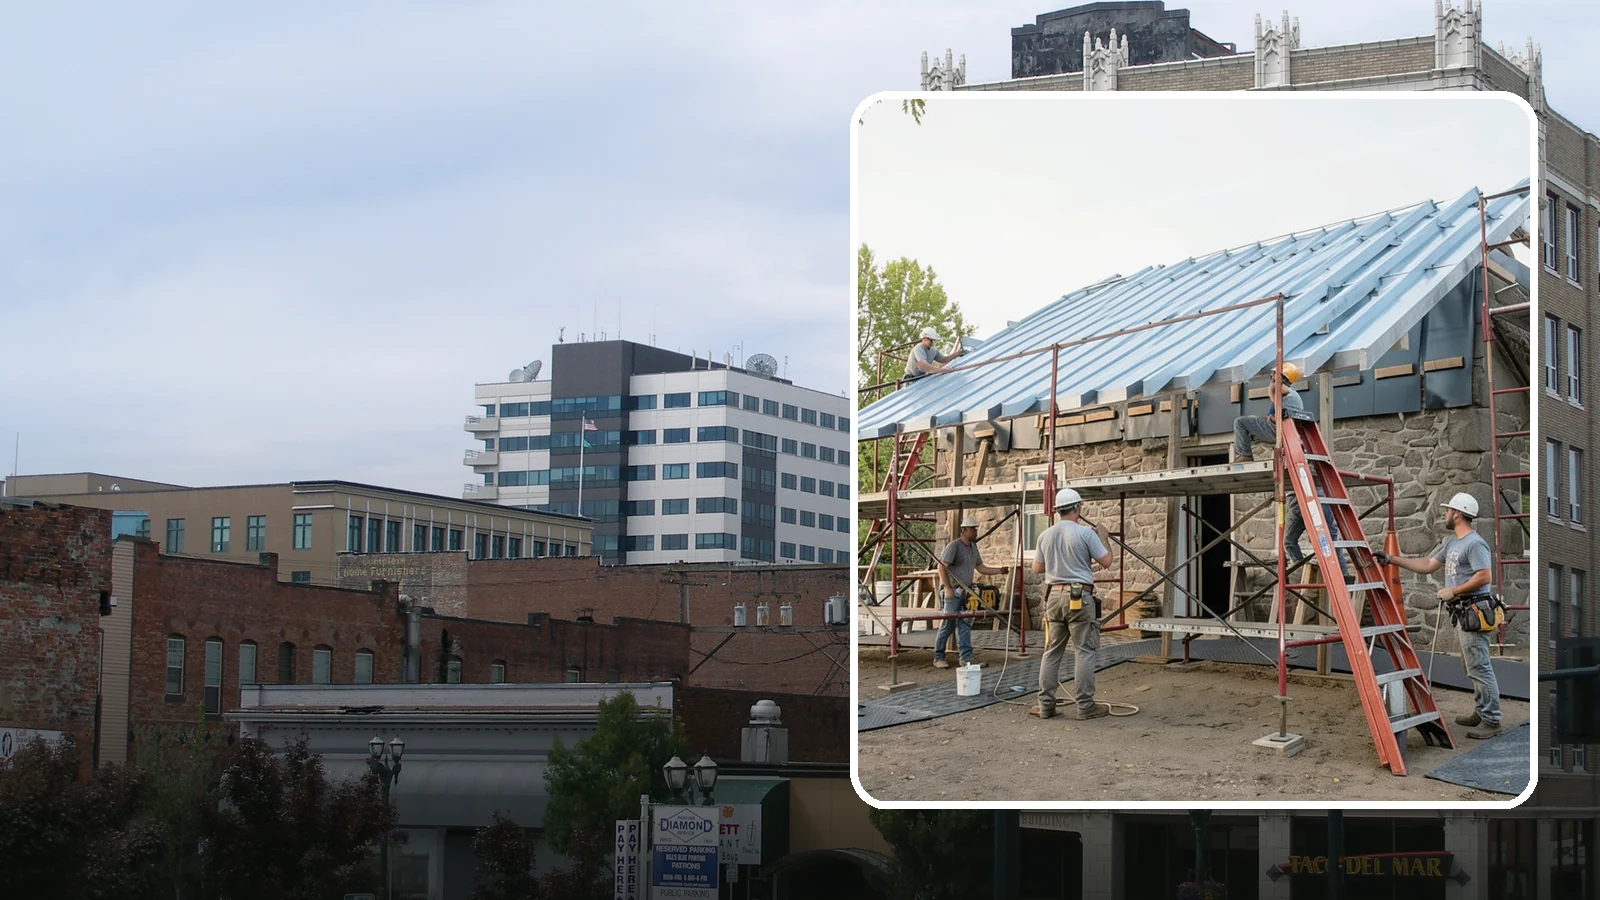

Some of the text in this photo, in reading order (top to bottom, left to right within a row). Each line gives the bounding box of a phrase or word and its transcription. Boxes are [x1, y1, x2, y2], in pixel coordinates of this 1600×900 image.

[343, 566, 427, 577] Home Furnishers
[660, 818, 713, 833] DIAMOND
[1022, 815, 1070, 828] BUILDING
[656, 845, 716, 854] RESERVED PARKING
[616, 825, 625, 894] PAY HERE
[627, 824, 637, 893] PAY HERE
[721, 851, 739, 863] Soup
[671, 862, 701, 870] PATRONS
[1346, 856, 1385, 875] DEL
[1392, 857, 1443, 877] MAR
[660, 888, 710, 898] PUBLIC PARKING
